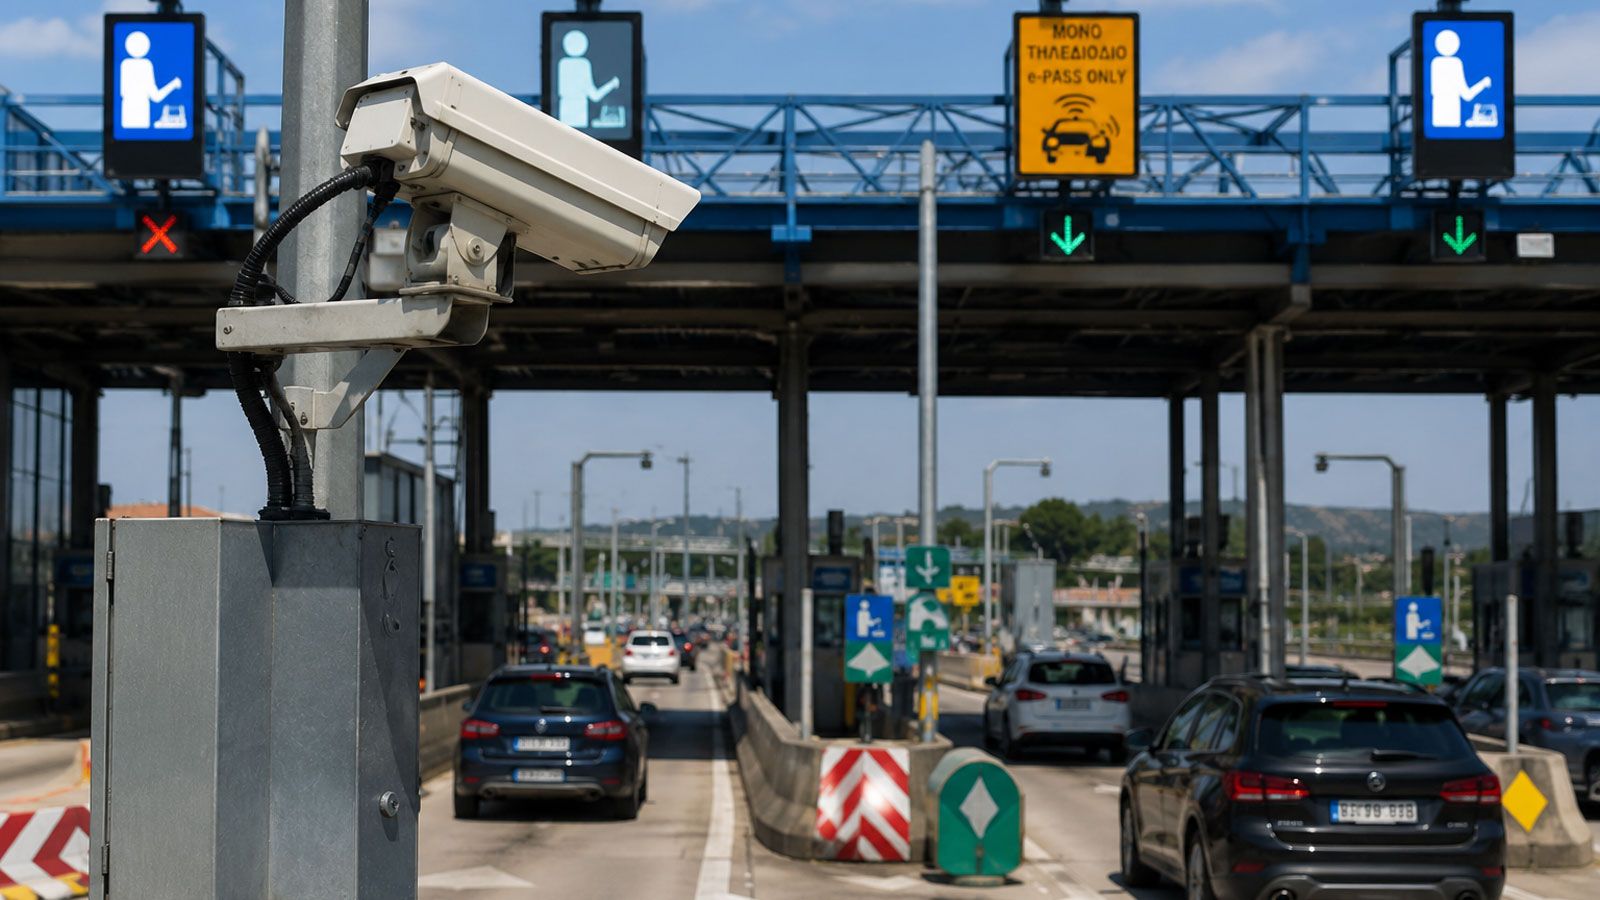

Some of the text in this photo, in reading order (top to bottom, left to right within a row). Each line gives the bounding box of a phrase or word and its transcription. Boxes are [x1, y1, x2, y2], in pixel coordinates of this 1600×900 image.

[1053, 24, 1102, 39] ΜΟΝΟ
[1027, 45, 1127, 60] ΤΗΛΕΔΙΟΔΙΟ
[1027, 69, 1126, 84] e-PASS ONLY
